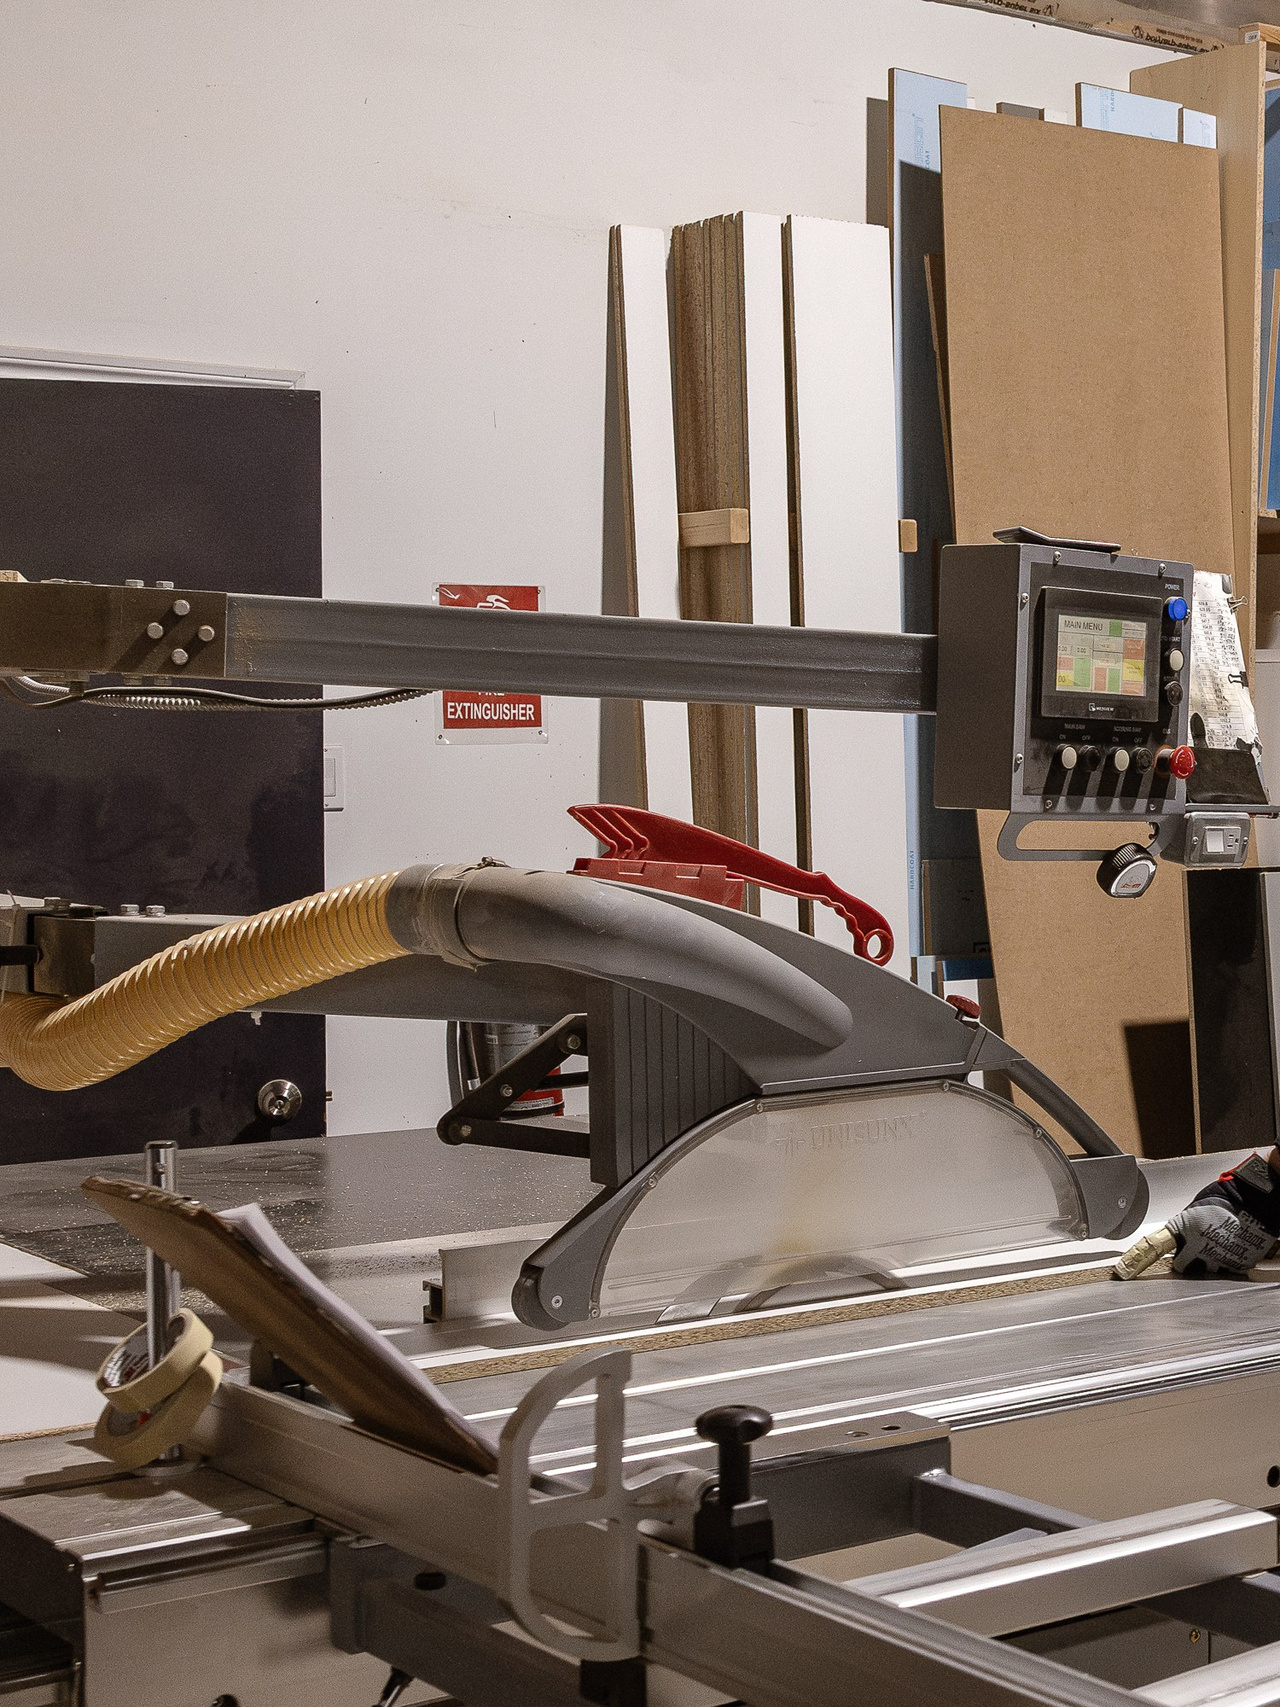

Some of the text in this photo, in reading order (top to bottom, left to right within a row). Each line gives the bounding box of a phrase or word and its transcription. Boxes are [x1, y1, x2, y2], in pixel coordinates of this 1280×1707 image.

[1164, 583, 1180, 591] POWER
[1064, 619, 1103, 631] MAIN MENU
[447, 702, 535, 721] EXTINGUISHER
